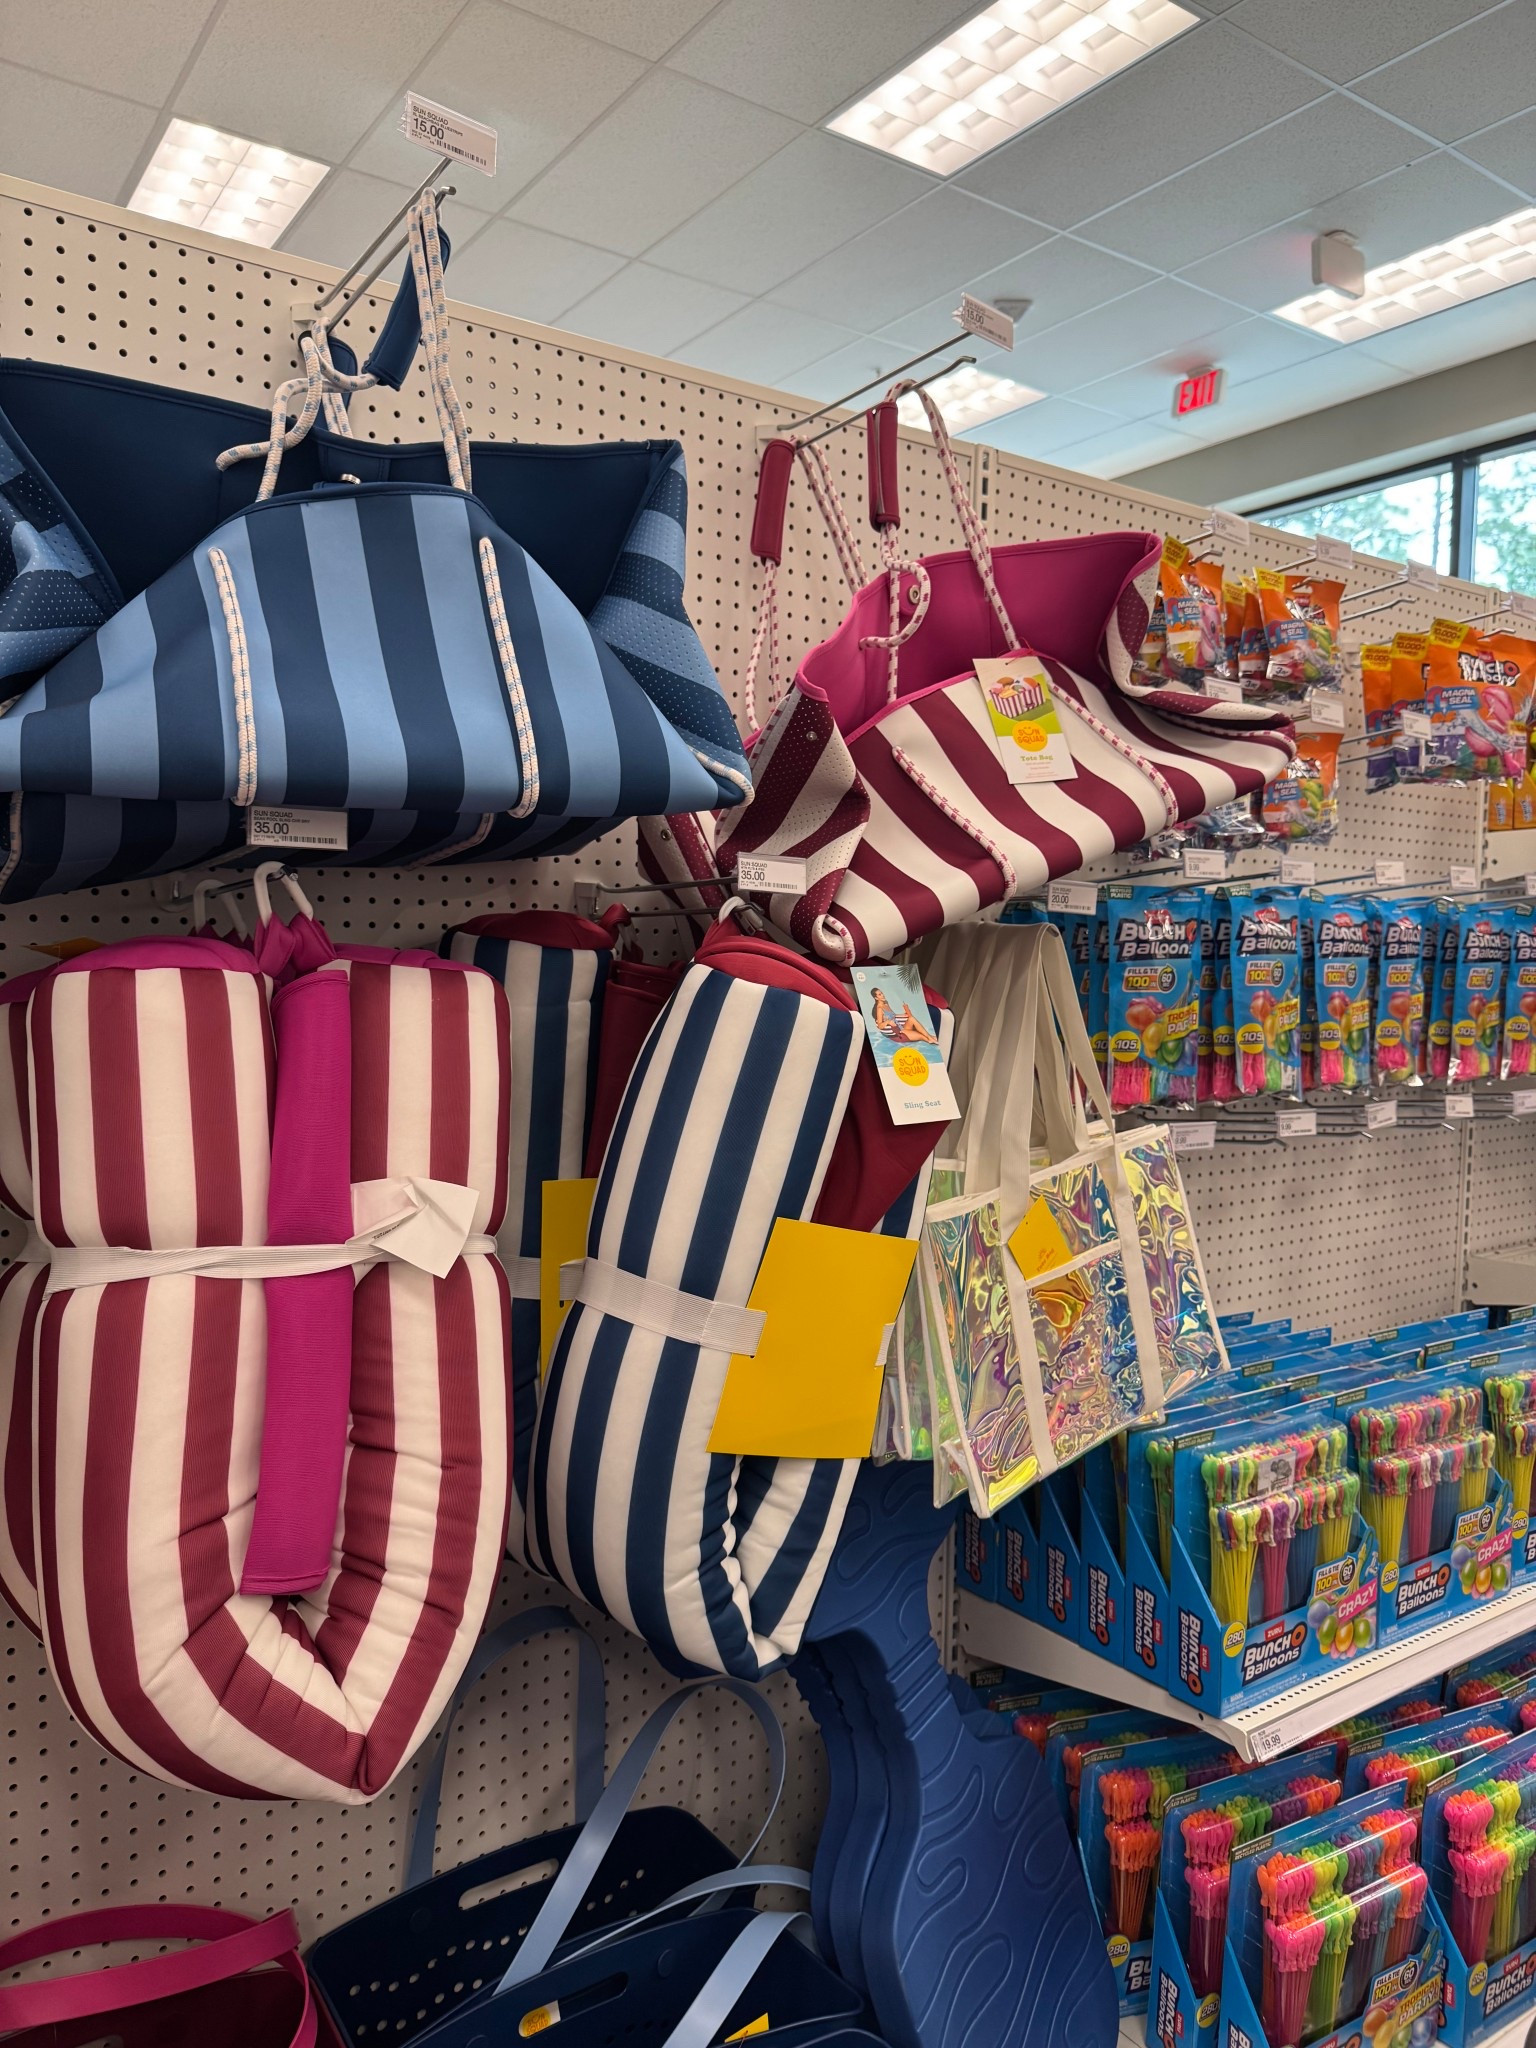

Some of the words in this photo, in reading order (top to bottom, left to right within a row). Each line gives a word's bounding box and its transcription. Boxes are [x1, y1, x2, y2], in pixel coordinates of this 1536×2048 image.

[412, 106, 426, 116] SUN
[427, 110, 448, 126] SQUAD
[414, 118, 444, 140] 15.00
[967, 309, 984, 324] 15.00
[1178, 370, 1218, 414] EXIT
[1281, 622, 1305, 630] MAGNA
[1442, 689, 1475, 698] MAGNA
[1018, 735, 1044, 744] SQUAD
[254, 821, 289, 834] 35.00
[741, 870, 765, 881] 35.00
[1052, 895, 1069, 904] 20.00
[1241, 938, 1297, 951] Balloon
[1127, 977, 1150, 987] 100
[1162, 974, 1172, 982] 60
[1115, 1040, 1137, 1049] 105
[899, 1057, 921, 1067] SUN
[899, 1065, 926, 1076] SQUAD
[1482, 1514, 1490, 1523] 60
[1460, 1524, 1472, 1536] 100
[1478, 1532, 1511, 1562] CRAZY
[1343, 1566, 1352, 1575] 60
[1385, 1569, 1398, 1581] 280
[1317, 1576, 1332, 1591] 100
[1339, 1584, 1375, 1618] CRAZY
[1399, 1586, 1445, 1614] Balloons
[1227, 1631, 1244, 1644] 280
[1268, 1626, 1283, 1637] ZURU
[1181, 1612, 1189, 1680] Balloons
[1246, 1647, 1299, 1680] Balloons
[1263, 1734, 1280, 1750] 19.99
[1235, 1848, 1253, 1860] RECYCLED
[1254, 1842, 1271, 1853] PLASTIC
[1109, 1944, 1128, 1955] 280
[1404, 1967, 1414, 1979] 60
[1377, 1978, 1388, 1986] FILL
[1375, 1982, 1391, 1999] 100
[1401, 1978, 1439, 2012] TROPICAL
[1486, 1975, 1532, 2015] Balloons
[1158, 1973, 1168, 2039] Balloons
[1202, 2001, 1218, 2017] 280
[1399, 1986, 1439, 2025] PARTY!
